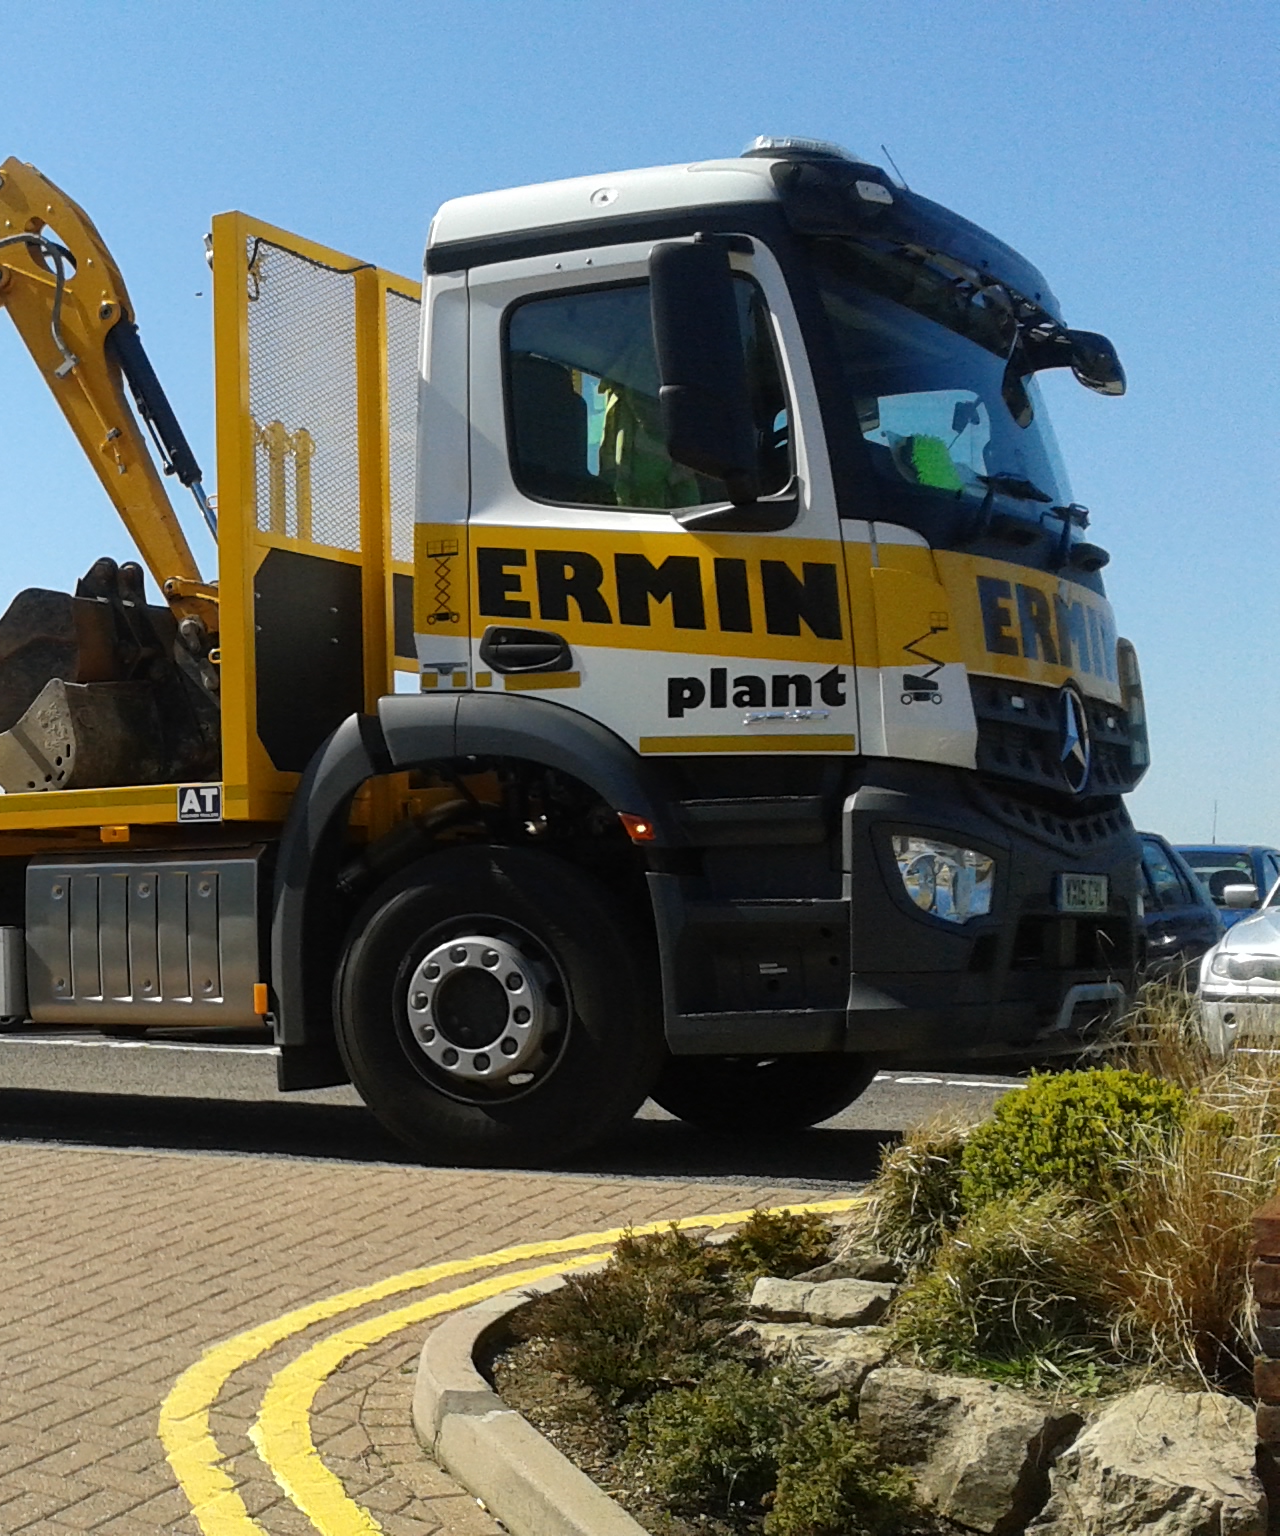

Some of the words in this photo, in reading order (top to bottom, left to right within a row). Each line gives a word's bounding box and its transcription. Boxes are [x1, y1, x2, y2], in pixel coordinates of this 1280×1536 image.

[476, 546, 843, 640] ERMIN
[976, 575, 1116, 683] ERMIN
[667, 665, 846, 718] plant
[181, 788, 218, 813] AT
